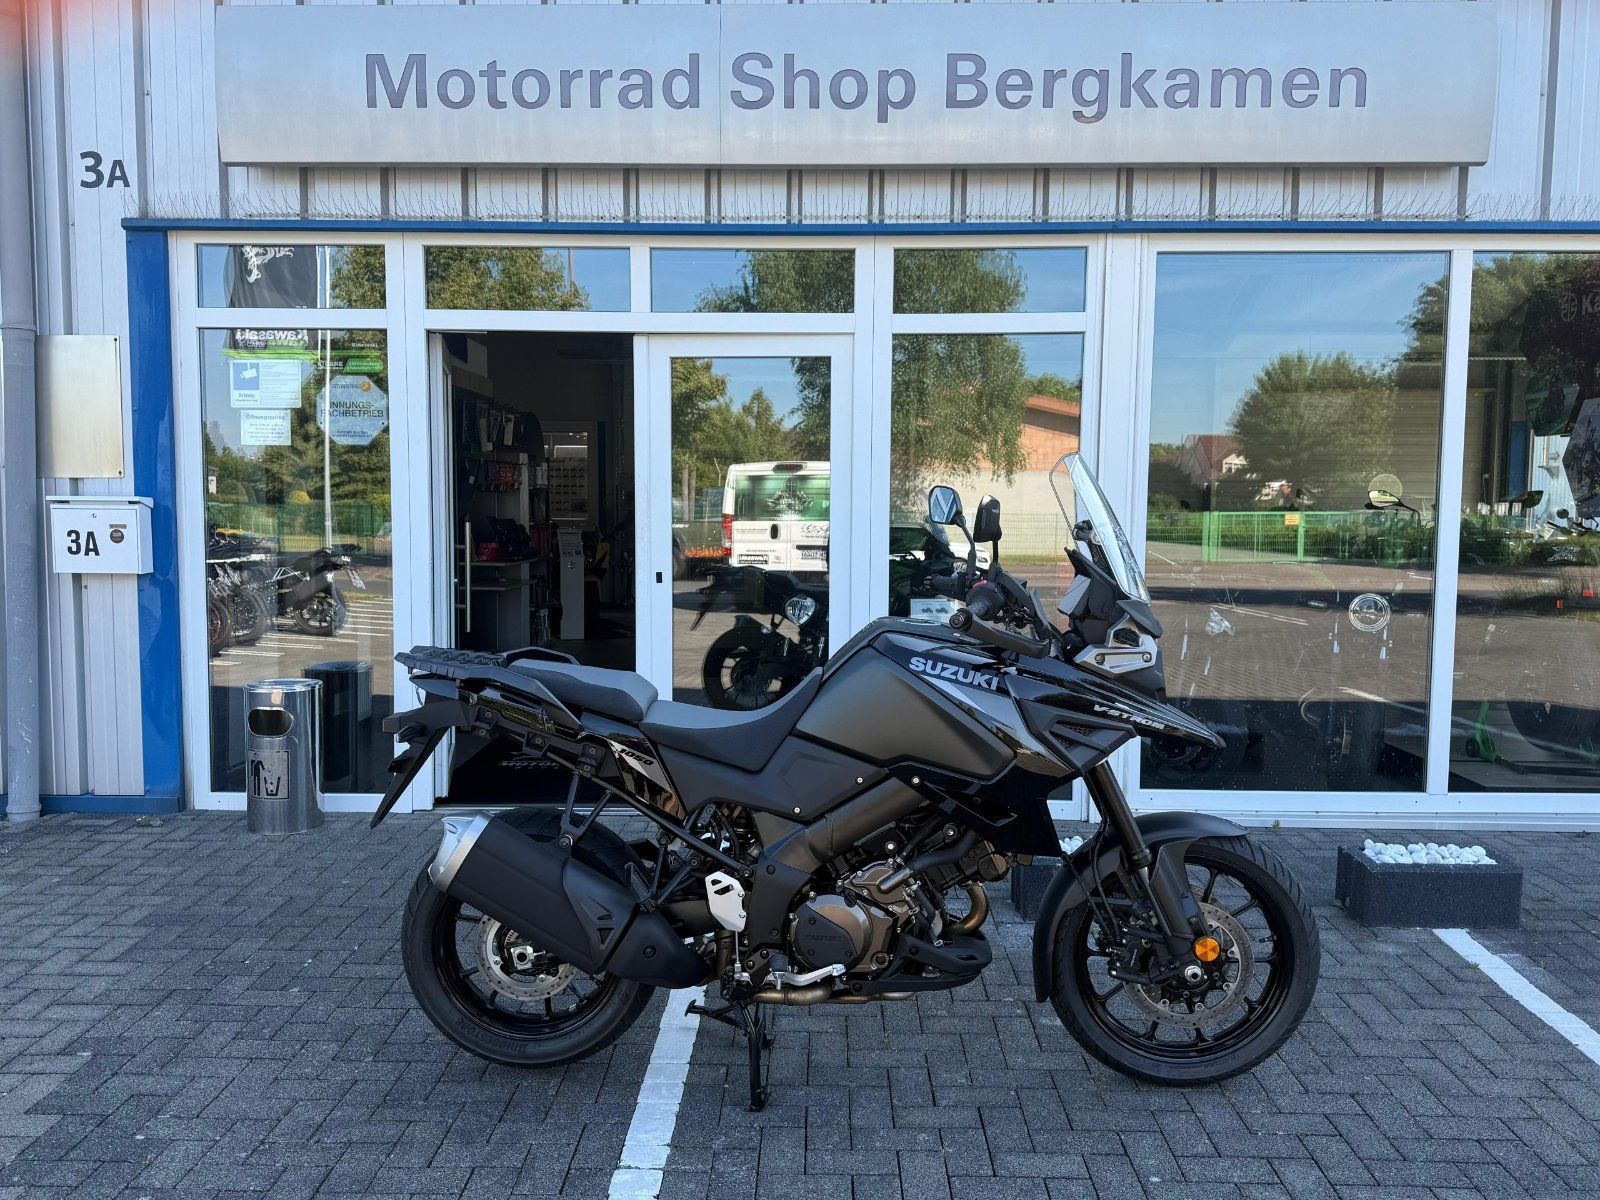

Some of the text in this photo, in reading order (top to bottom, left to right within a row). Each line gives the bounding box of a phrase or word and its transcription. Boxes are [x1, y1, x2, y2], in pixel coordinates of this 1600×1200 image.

[365, 52, 1368, 124] Motorrad Shop Bergkamen
[79, 151, 131, 189] 3A
[329, 401, 375, 409] INNUNGS-
[67, 529, 100, 556] 3A
[908, 656, 999, 691] SUZUKI
[1093, 704, 1165, 730] V-STROM
[618, 748, 655, 766] 1050
